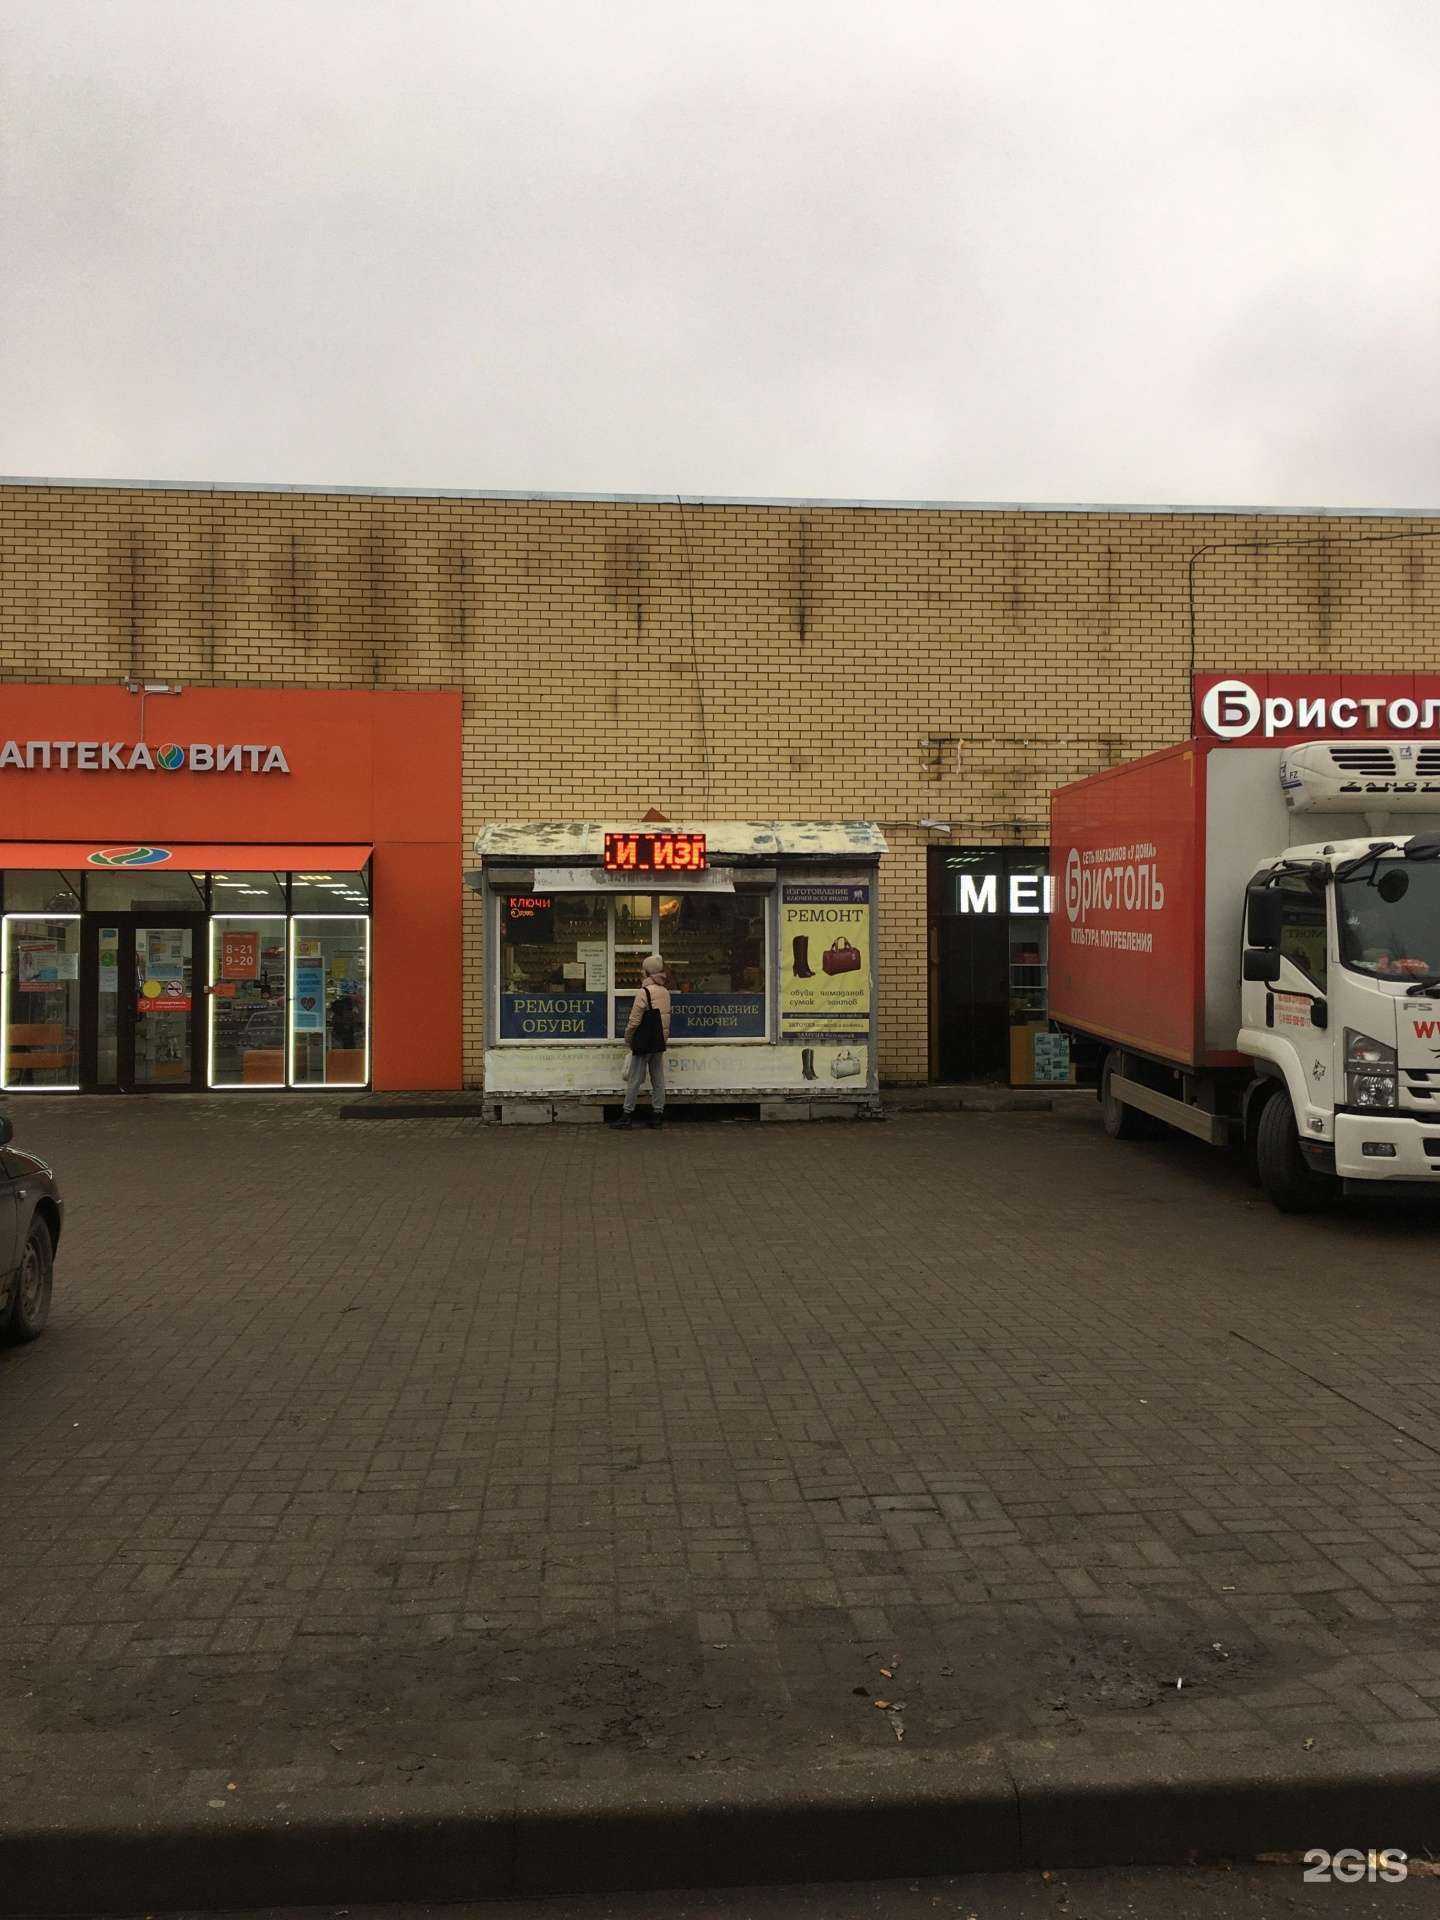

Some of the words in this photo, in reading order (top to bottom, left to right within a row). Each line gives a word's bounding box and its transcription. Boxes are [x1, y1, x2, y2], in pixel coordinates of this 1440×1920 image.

[0, 741, 155, 769] АПТЕКА
[189, 743, 290, 773] ВИТА
[616, 841, 637, 864] И
[1066, 848, 1165, 923] Бристоль
[510, 898, 551, 908] КЛЮЧИ
[787, 910, 864, 922] РЕМОНТ
[1071, 928, 1099, 946] КУЛЬТУРА
[1100, 928, 1152, 952] ПОТРЕБЛЕНИЯ
[513, 1000, 594, 1013] РЕМОНТ
[522, 1020, 585, 1032] ОБУВИ
[687, 1017, 738, 1026] КЛЮЧЕЙ
